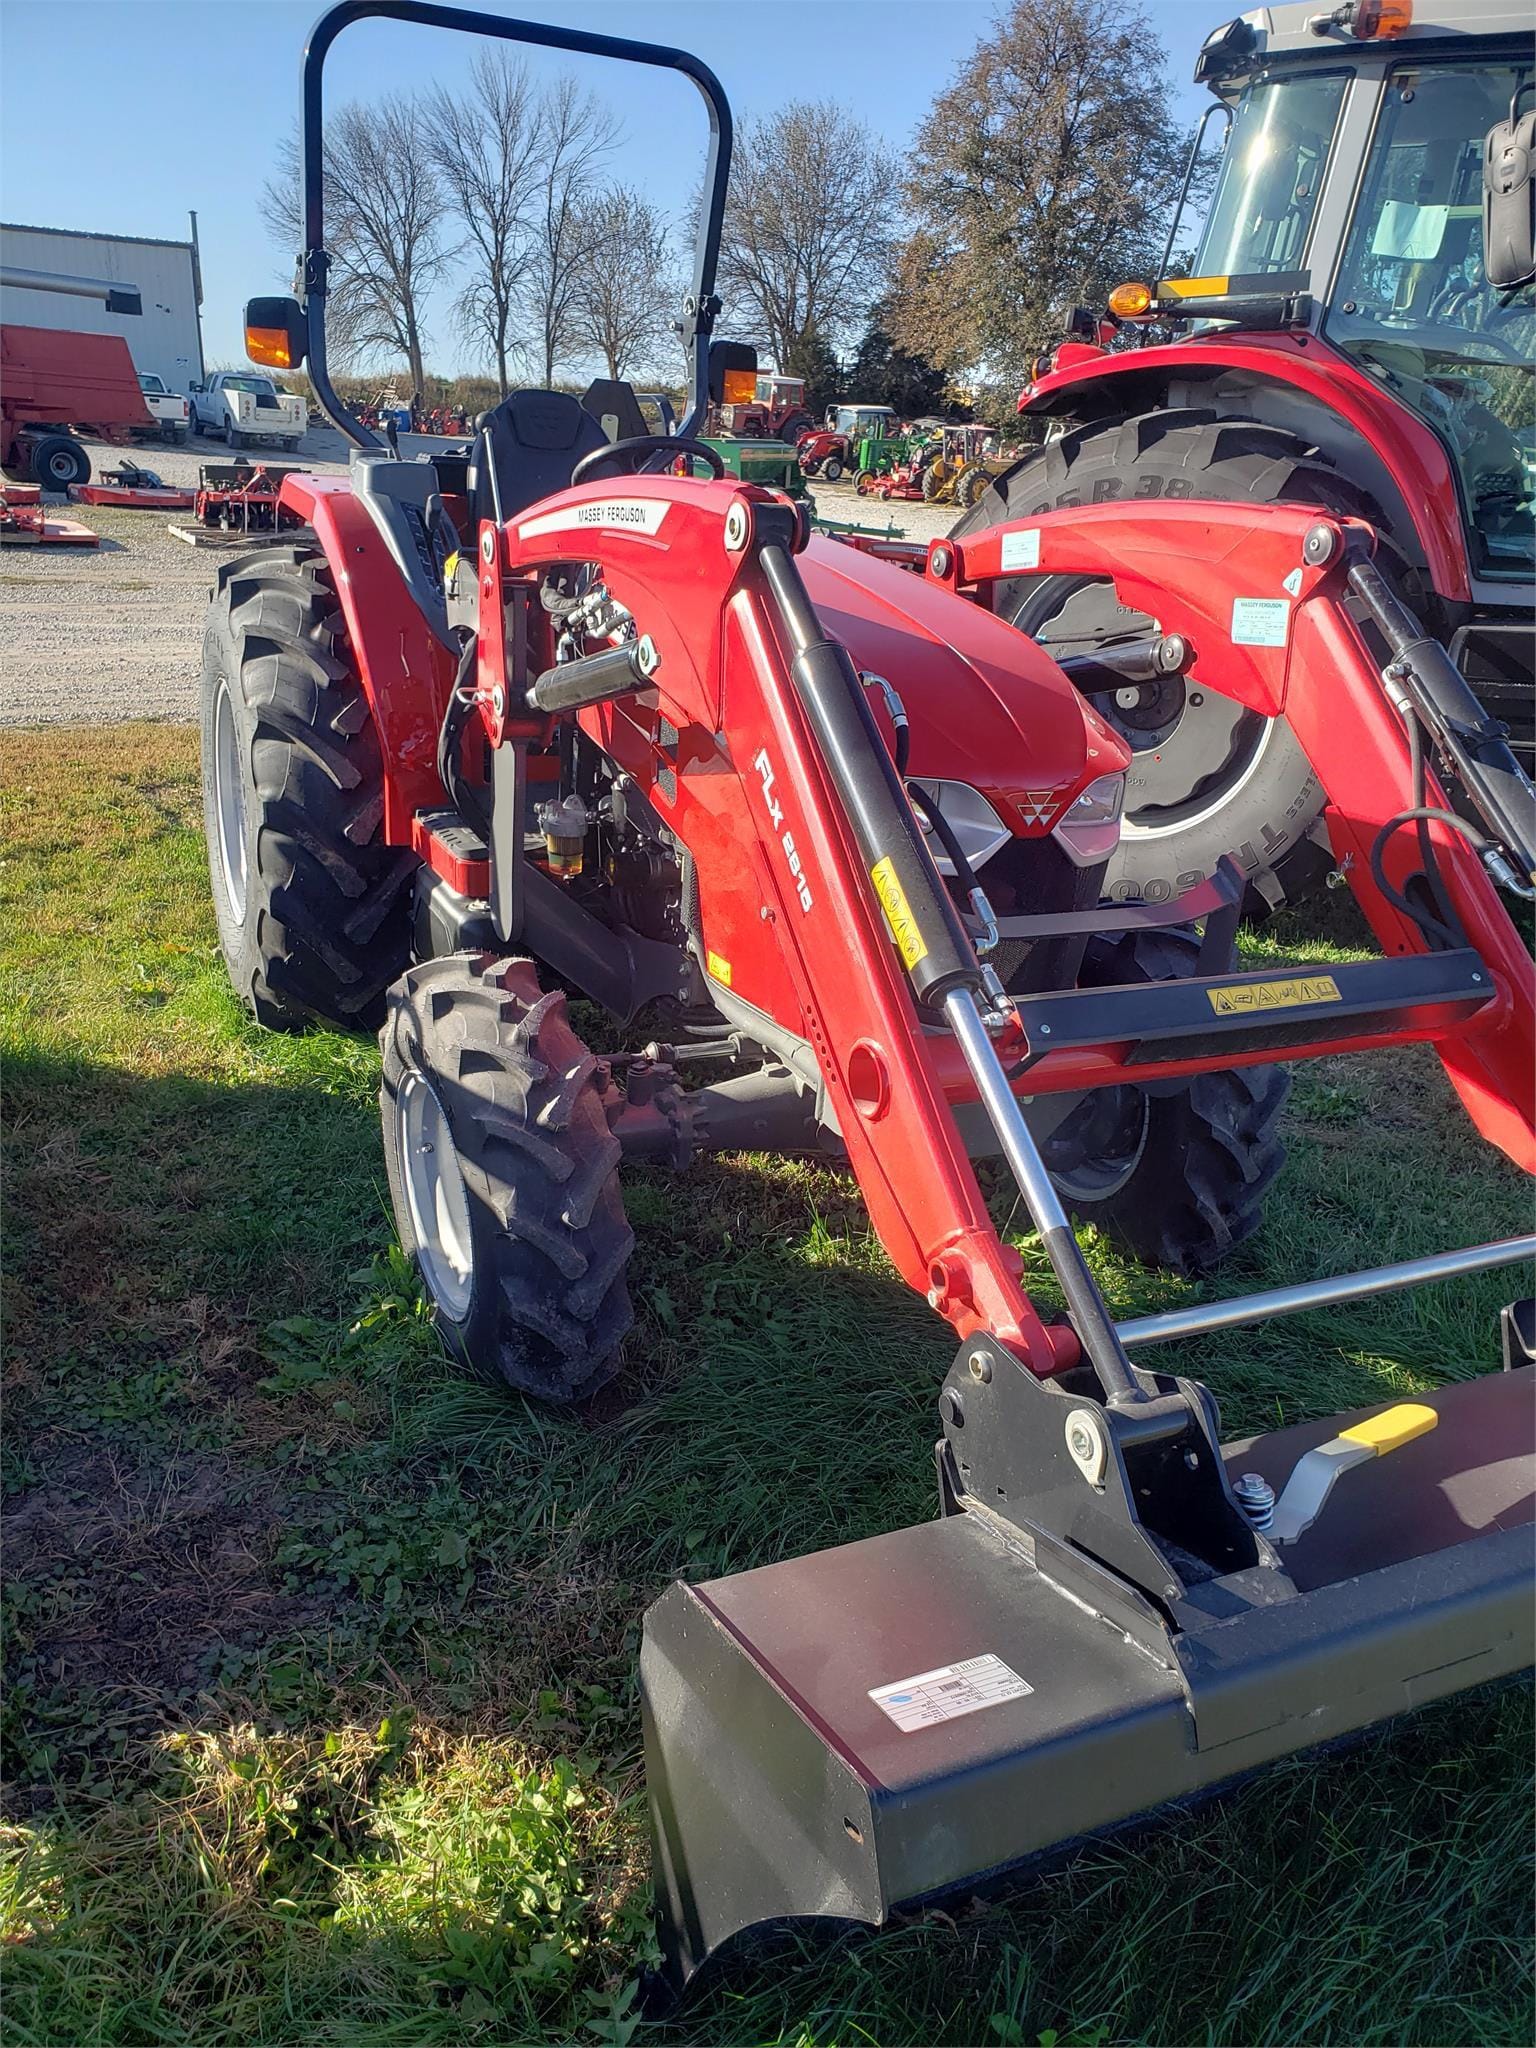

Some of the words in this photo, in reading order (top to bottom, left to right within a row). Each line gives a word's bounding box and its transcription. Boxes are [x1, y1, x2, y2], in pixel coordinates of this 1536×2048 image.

[1092, 476, 1123, 502] R
[1134, 475, 1194, 500] 38
[578, 508, 605, 523] MASSEY
[607, 507, 646, 524] FERGUSON
